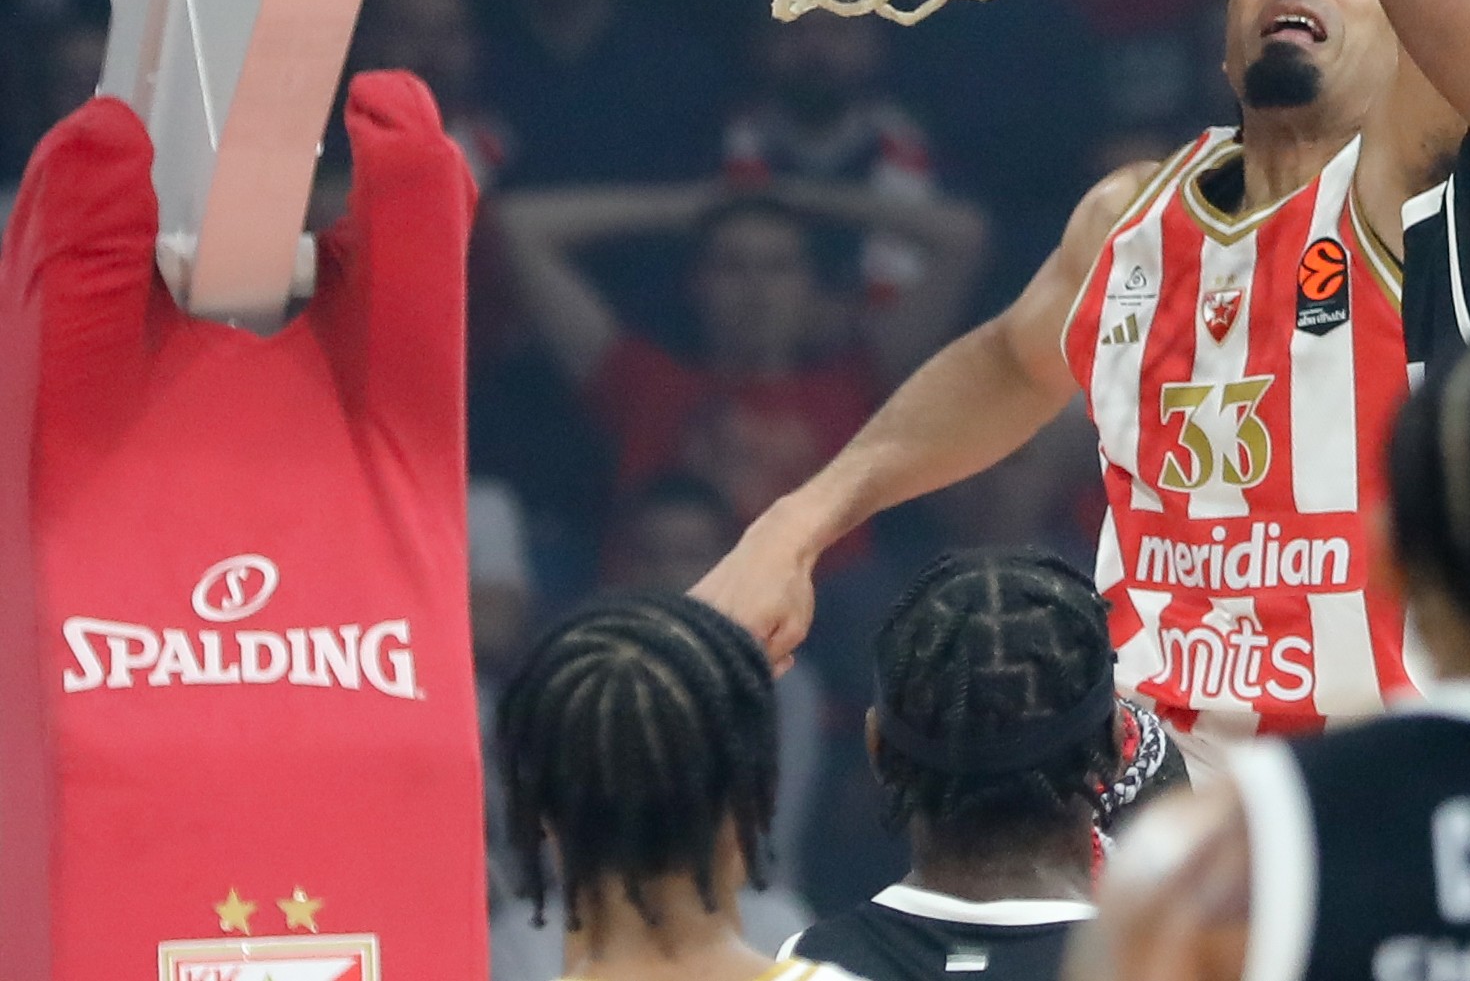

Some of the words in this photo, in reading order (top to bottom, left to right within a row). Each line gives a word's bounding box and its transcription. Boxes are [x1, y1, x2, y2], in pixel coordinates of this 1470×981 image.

[1157, 374, 1276, 492] 33
[1136, 522, 1350, 590] meridian
[62, 617, 418, 700] SPALDING
[1152, 617, 1315, 702] mts
